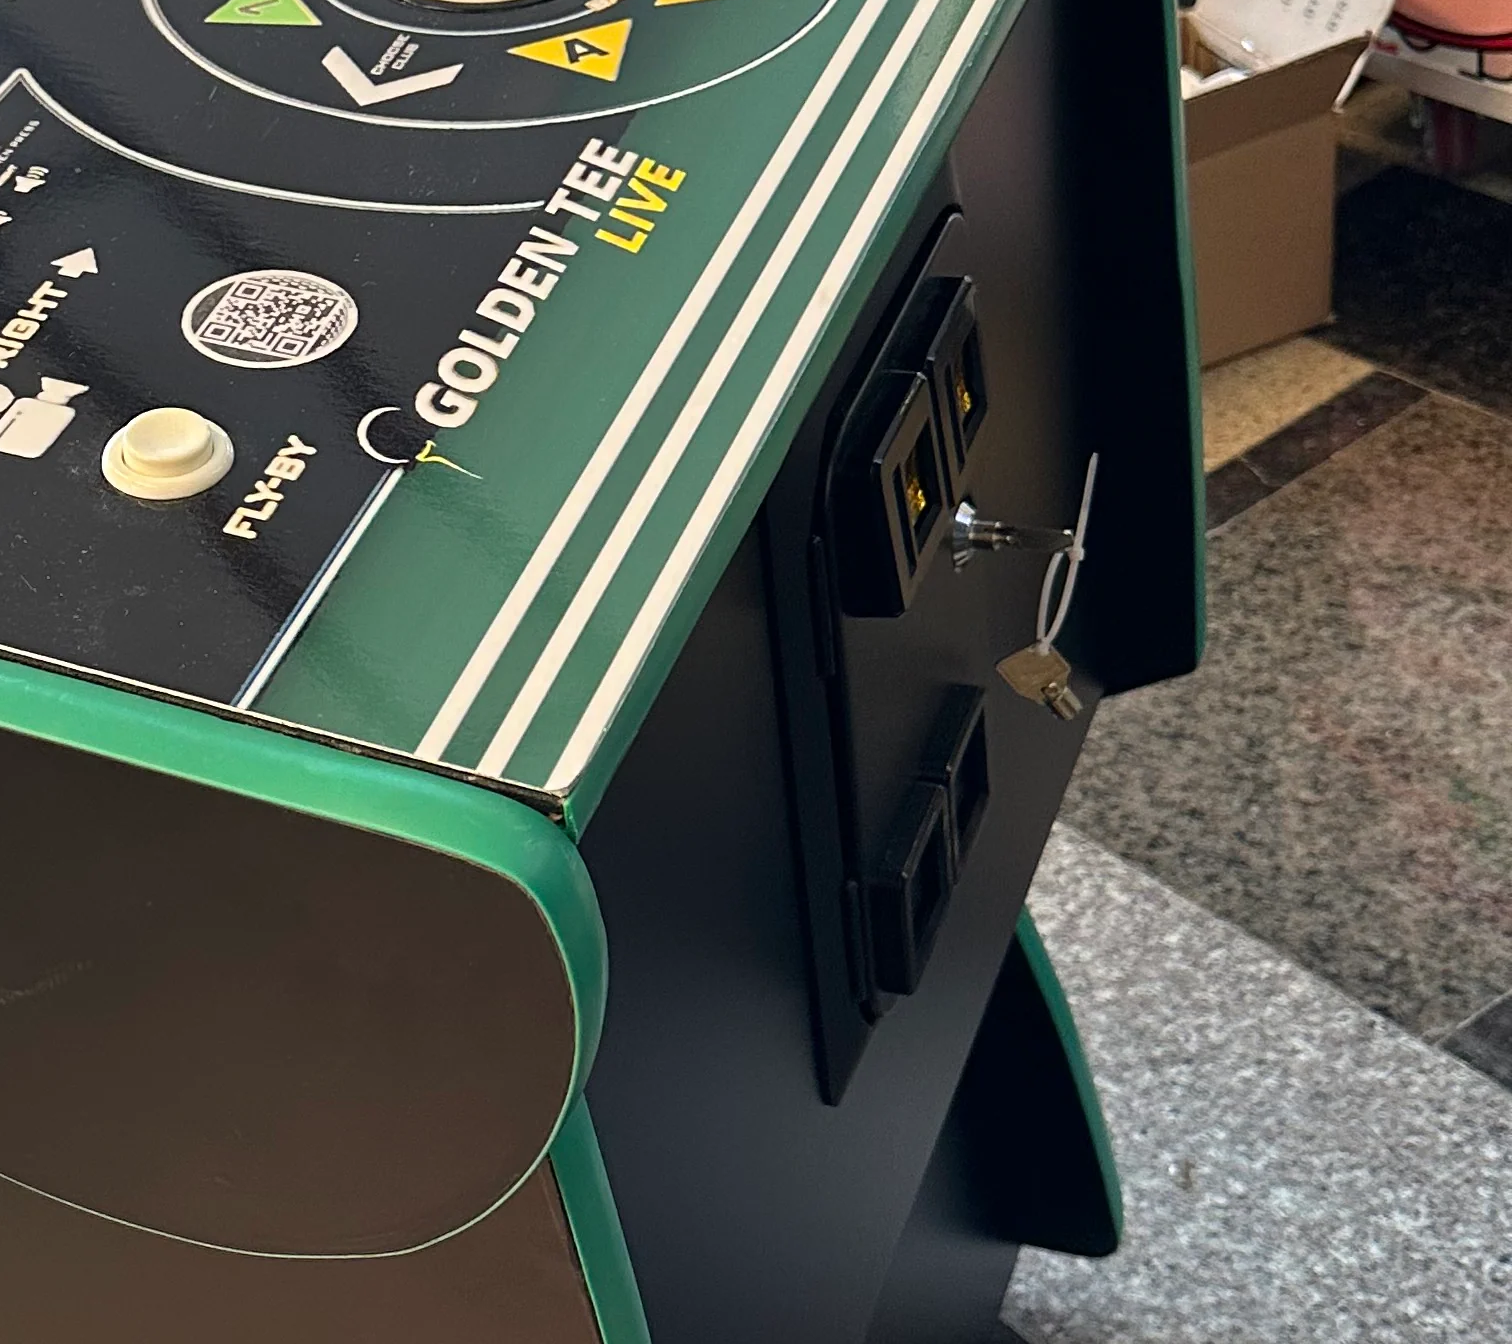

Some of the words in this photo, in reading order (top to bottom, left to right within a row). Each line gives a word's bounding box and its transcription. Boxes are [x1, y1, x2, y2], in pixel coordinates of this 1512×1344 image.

[370, 32, 410, 76] CHOOSE
[391, 42, 419, 71] CLUB
[562, 38, 611, 67] A
[594, 157, 686, 254] LIVE
[414, 225, 580, 428] GOLDEN
[544, 137, 639, 222] TEE
[222, 434, 319, 540] FLY-BY
